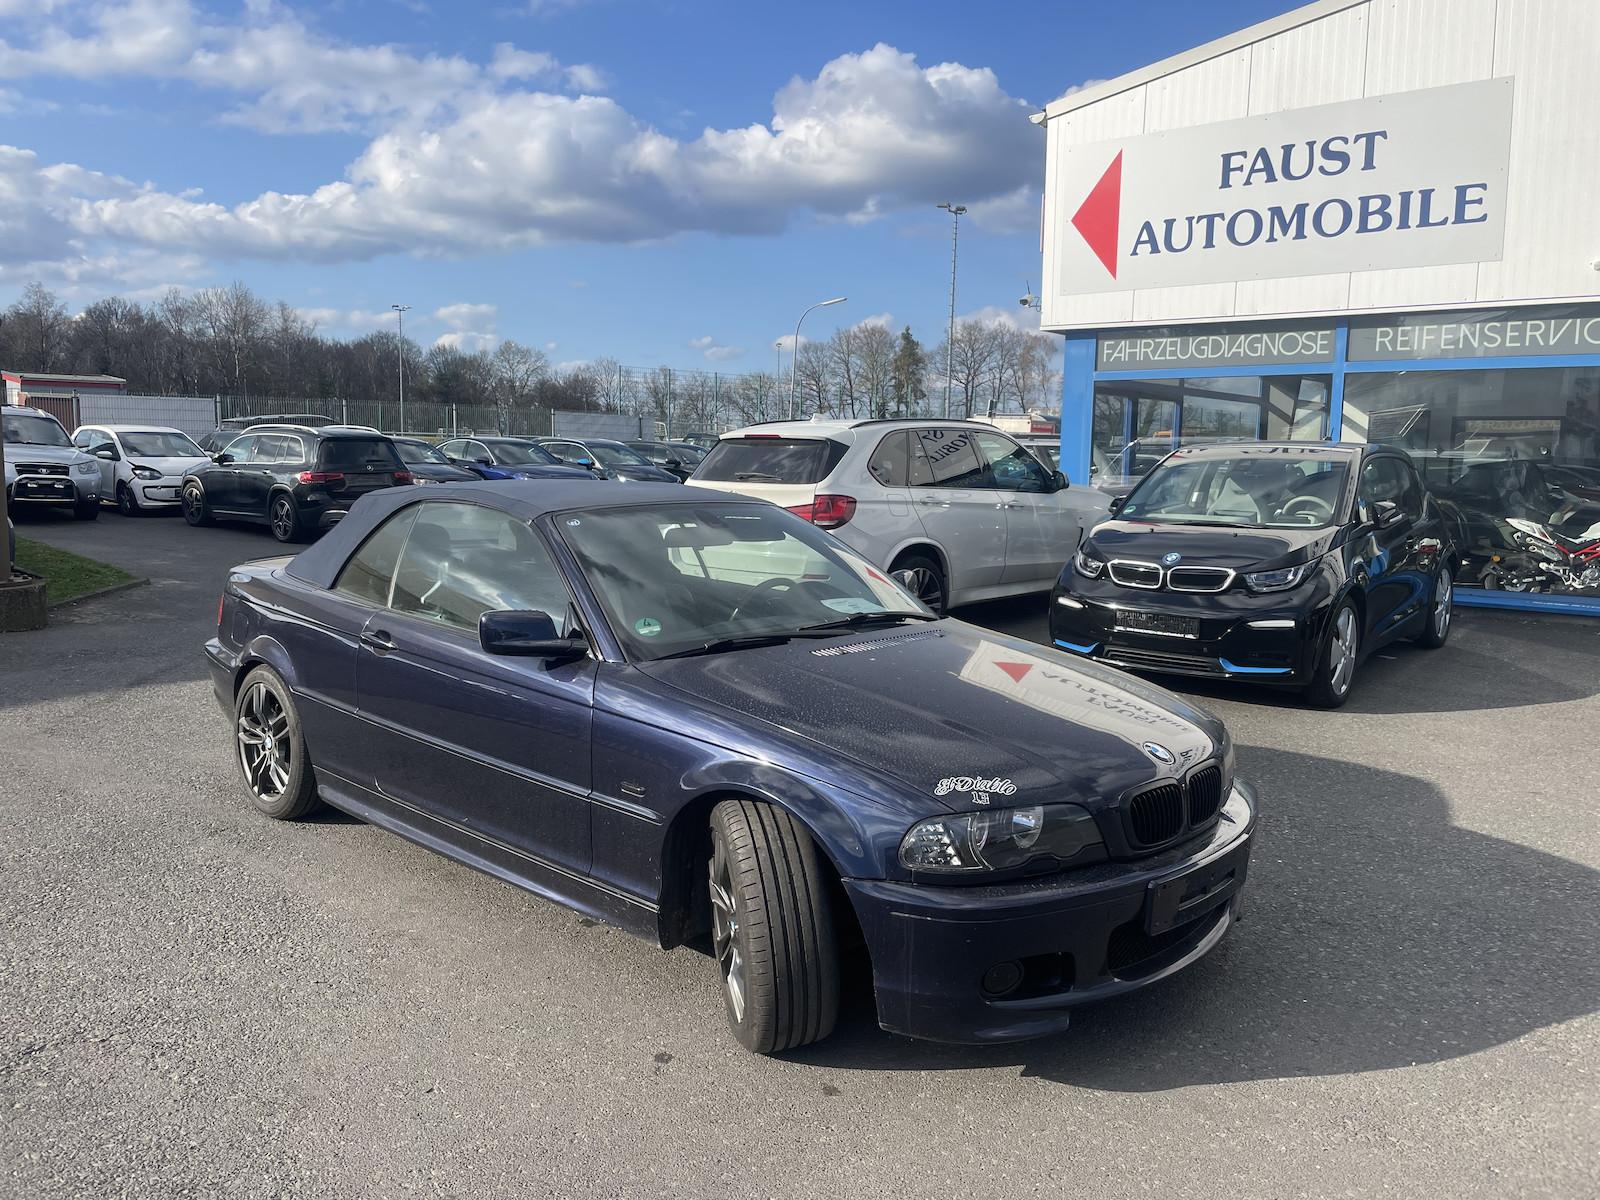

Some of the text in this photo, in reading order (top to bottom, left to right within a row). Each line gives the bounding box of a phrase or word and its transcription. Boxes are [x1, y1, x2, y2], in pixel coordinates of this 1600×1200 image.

[1218, 130, 1388, 189] FAUST
[1130, 182, 1488, 256] AUTOMOBILE
[1103, 331, 1331, 362] FAHRZEUGDIAGNOSE
